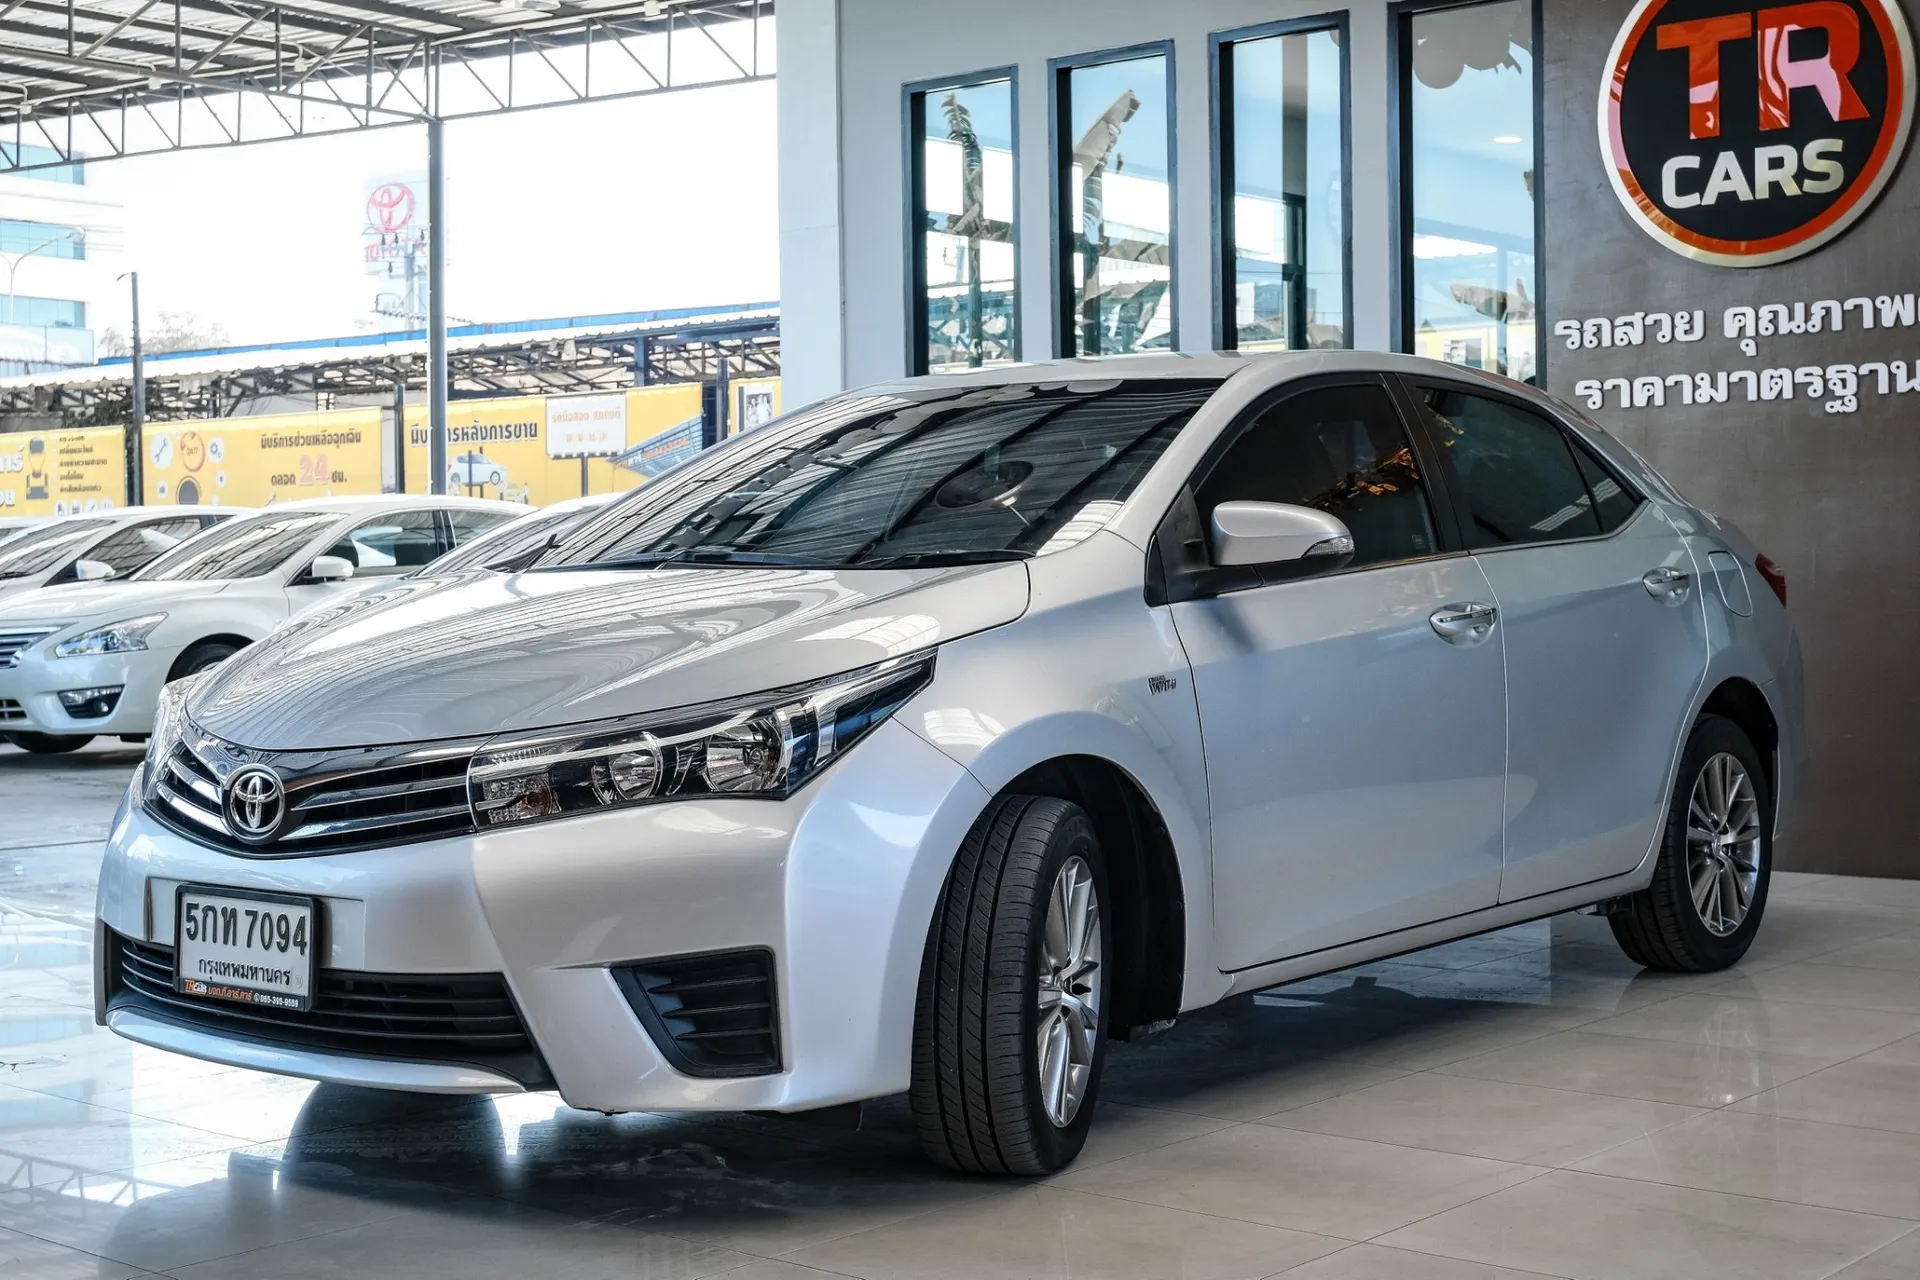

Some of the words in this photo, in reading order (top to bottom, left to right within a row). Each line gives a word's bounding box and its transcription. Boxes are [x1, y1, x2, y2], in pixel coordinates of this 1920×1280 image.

[1656, 0, 1871, 140] TR
[1661, 138, 1845, 209] CARS
[1554, 308, 1705, 351] รถสวย
[1723, 292, 1920, 357] คุณภาพ
[1575, 358, 1920, 414] ราคามาตรฐาน
[271, 473, 296, 486] ตลอด
[299, 454, 329, 486] 24
[185, 901, 238, 946] 5กท
[244, 908, 308, 956] 7094
[199, 957, 291, 986] กรุงเทพมหานคร
